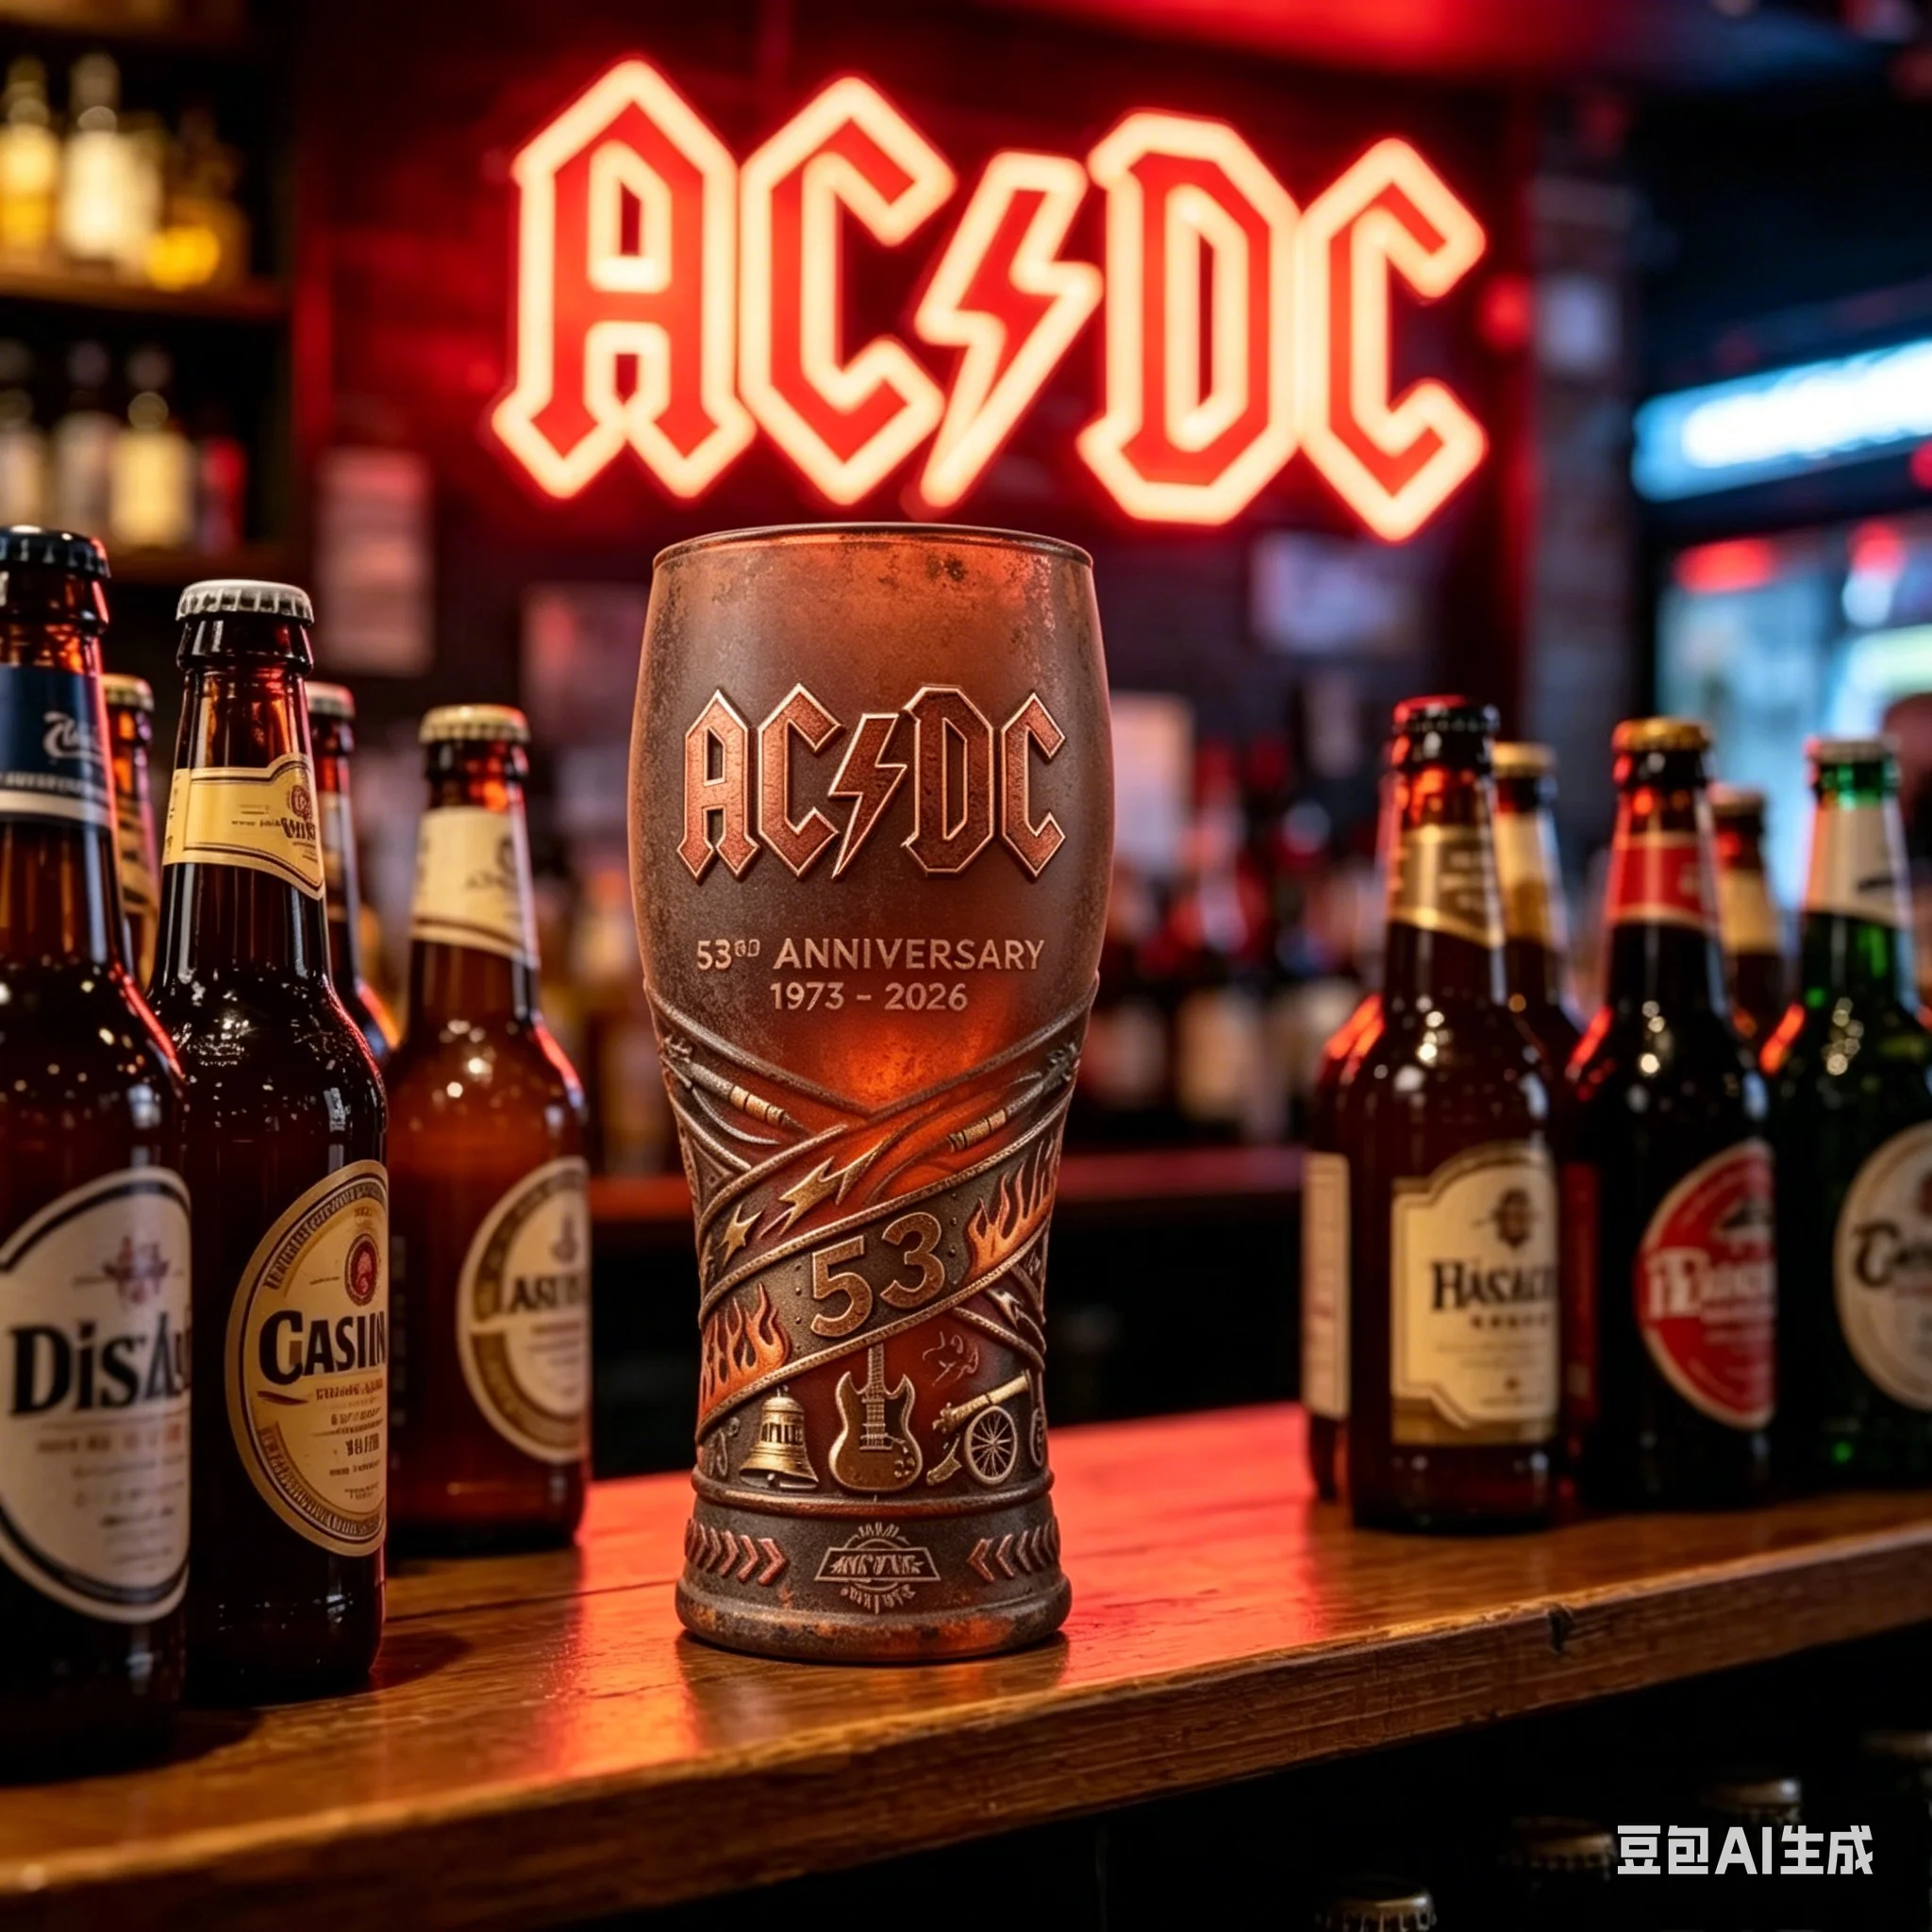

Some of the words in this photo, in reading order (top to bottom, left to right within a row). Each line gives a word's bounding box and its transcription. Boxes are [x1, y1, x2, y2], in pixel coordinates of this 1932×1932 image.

[773, 937, 1045, 972] ANNIVERSARY
[770, 981, 844, 1012] 1973
[884, 982, 969, 1012] 2026
[808, 1211, 946, 1340] 53
